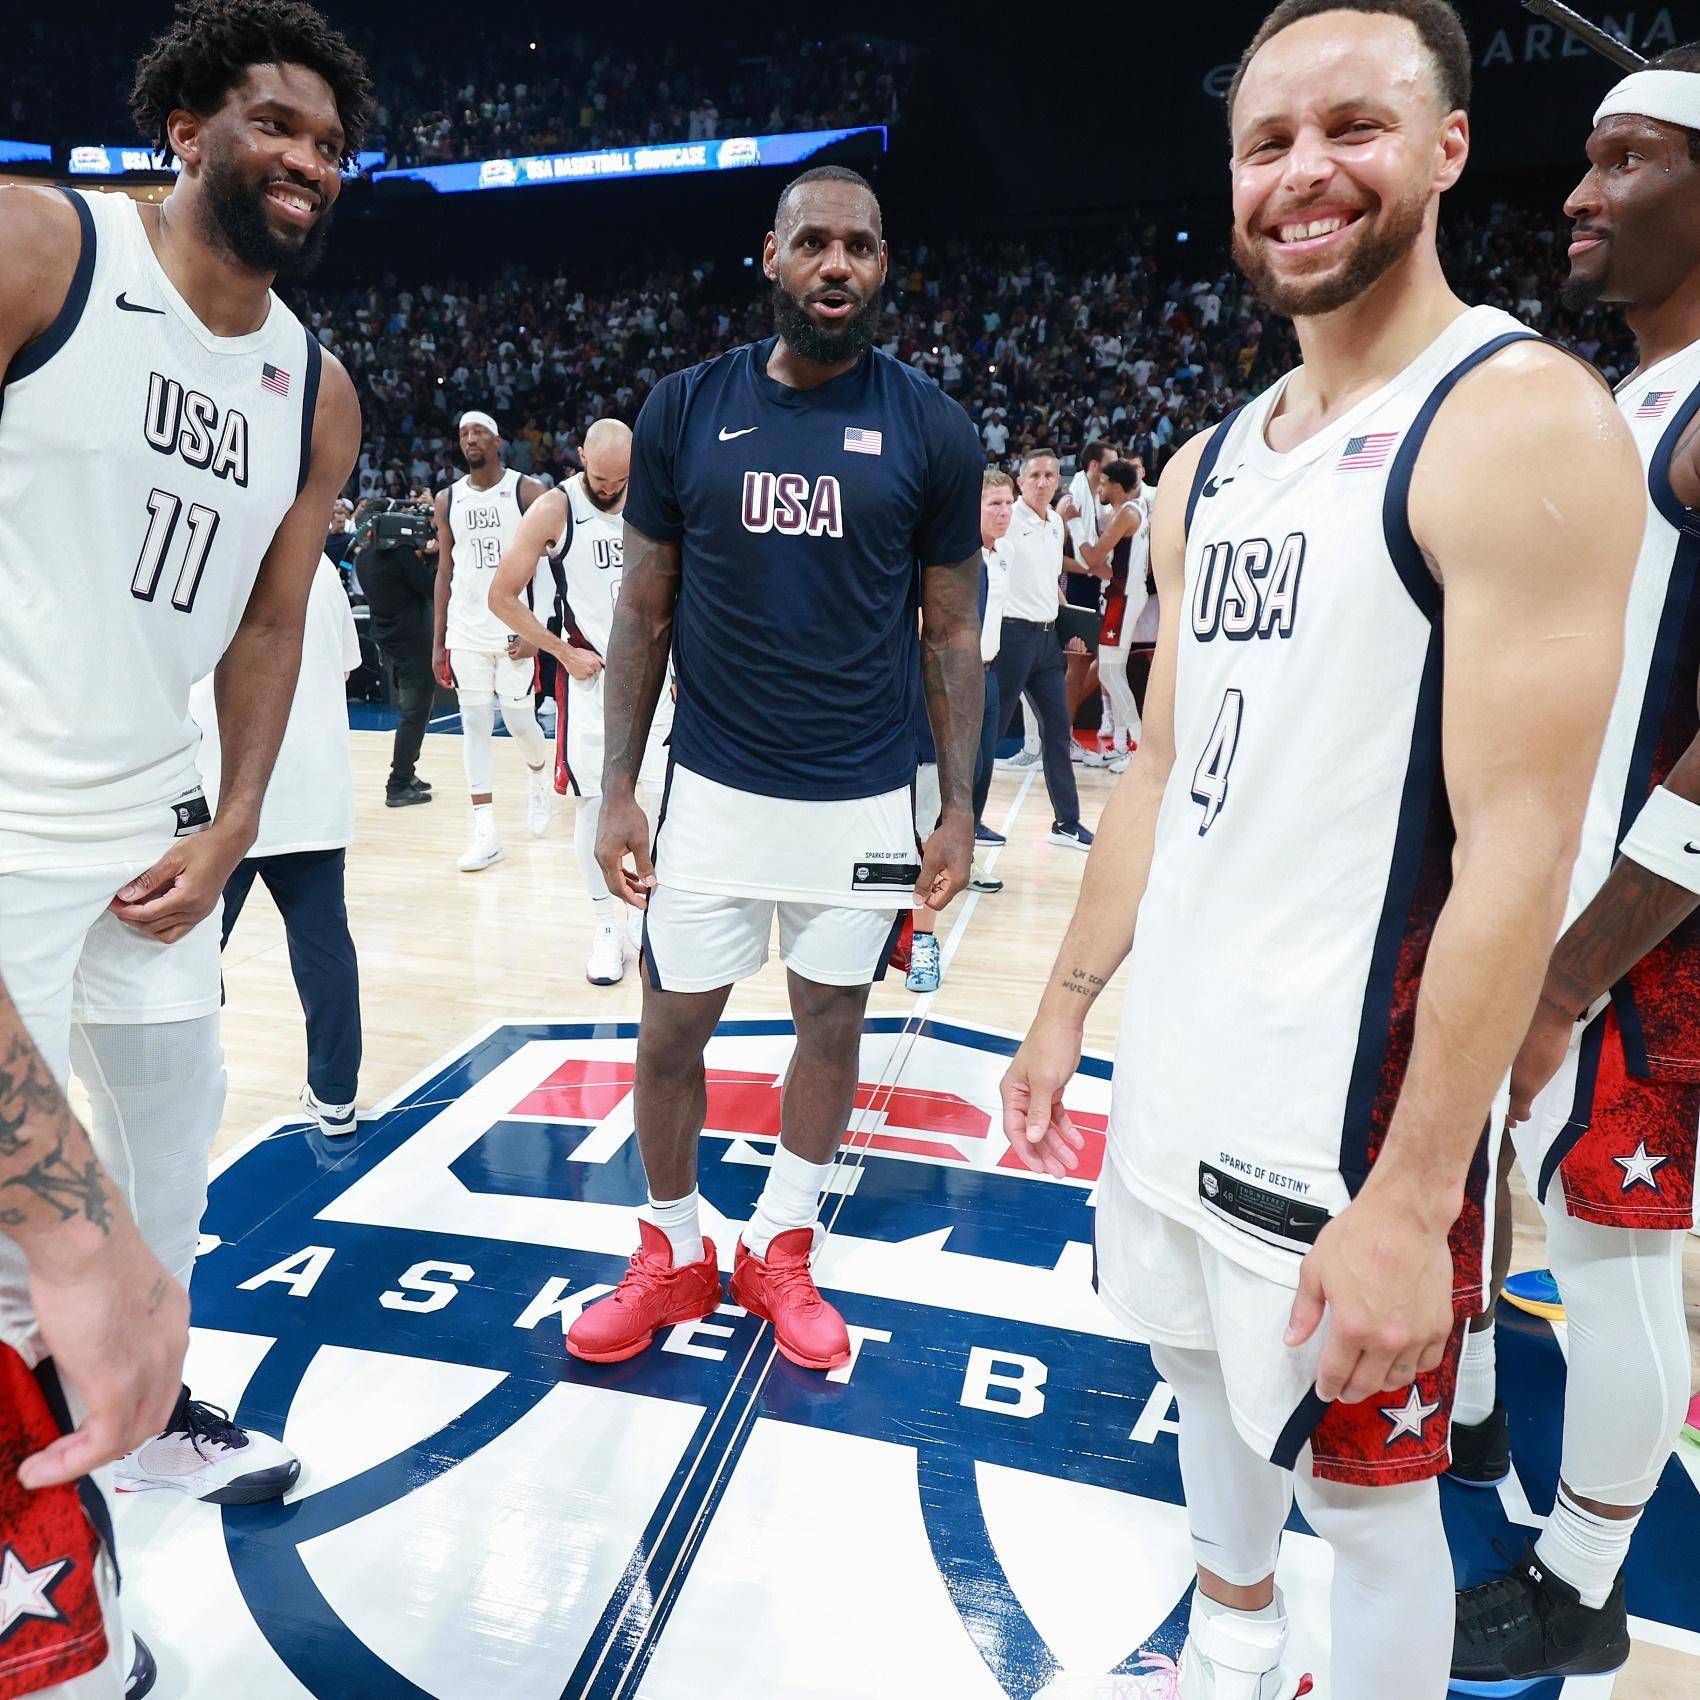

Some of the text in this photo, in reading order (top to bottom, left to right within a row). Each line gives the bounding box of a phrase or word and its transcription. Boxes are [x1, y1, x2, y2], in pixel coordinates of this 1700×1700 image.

[144, 371, 248, 488] USA
[465, 507, 500, 528] USA
[742, 471, 843, 538] USA
[131, 488, 220, 613] 11
[471, 537, 501, 569] 13
[593, 540, 623, 569] US
[1192, 532, 1306, 642] USA
[1191, 688, 1244, 836] 4
[1220, 1152, 1310, 1194] SPARKS OF DESTINY
